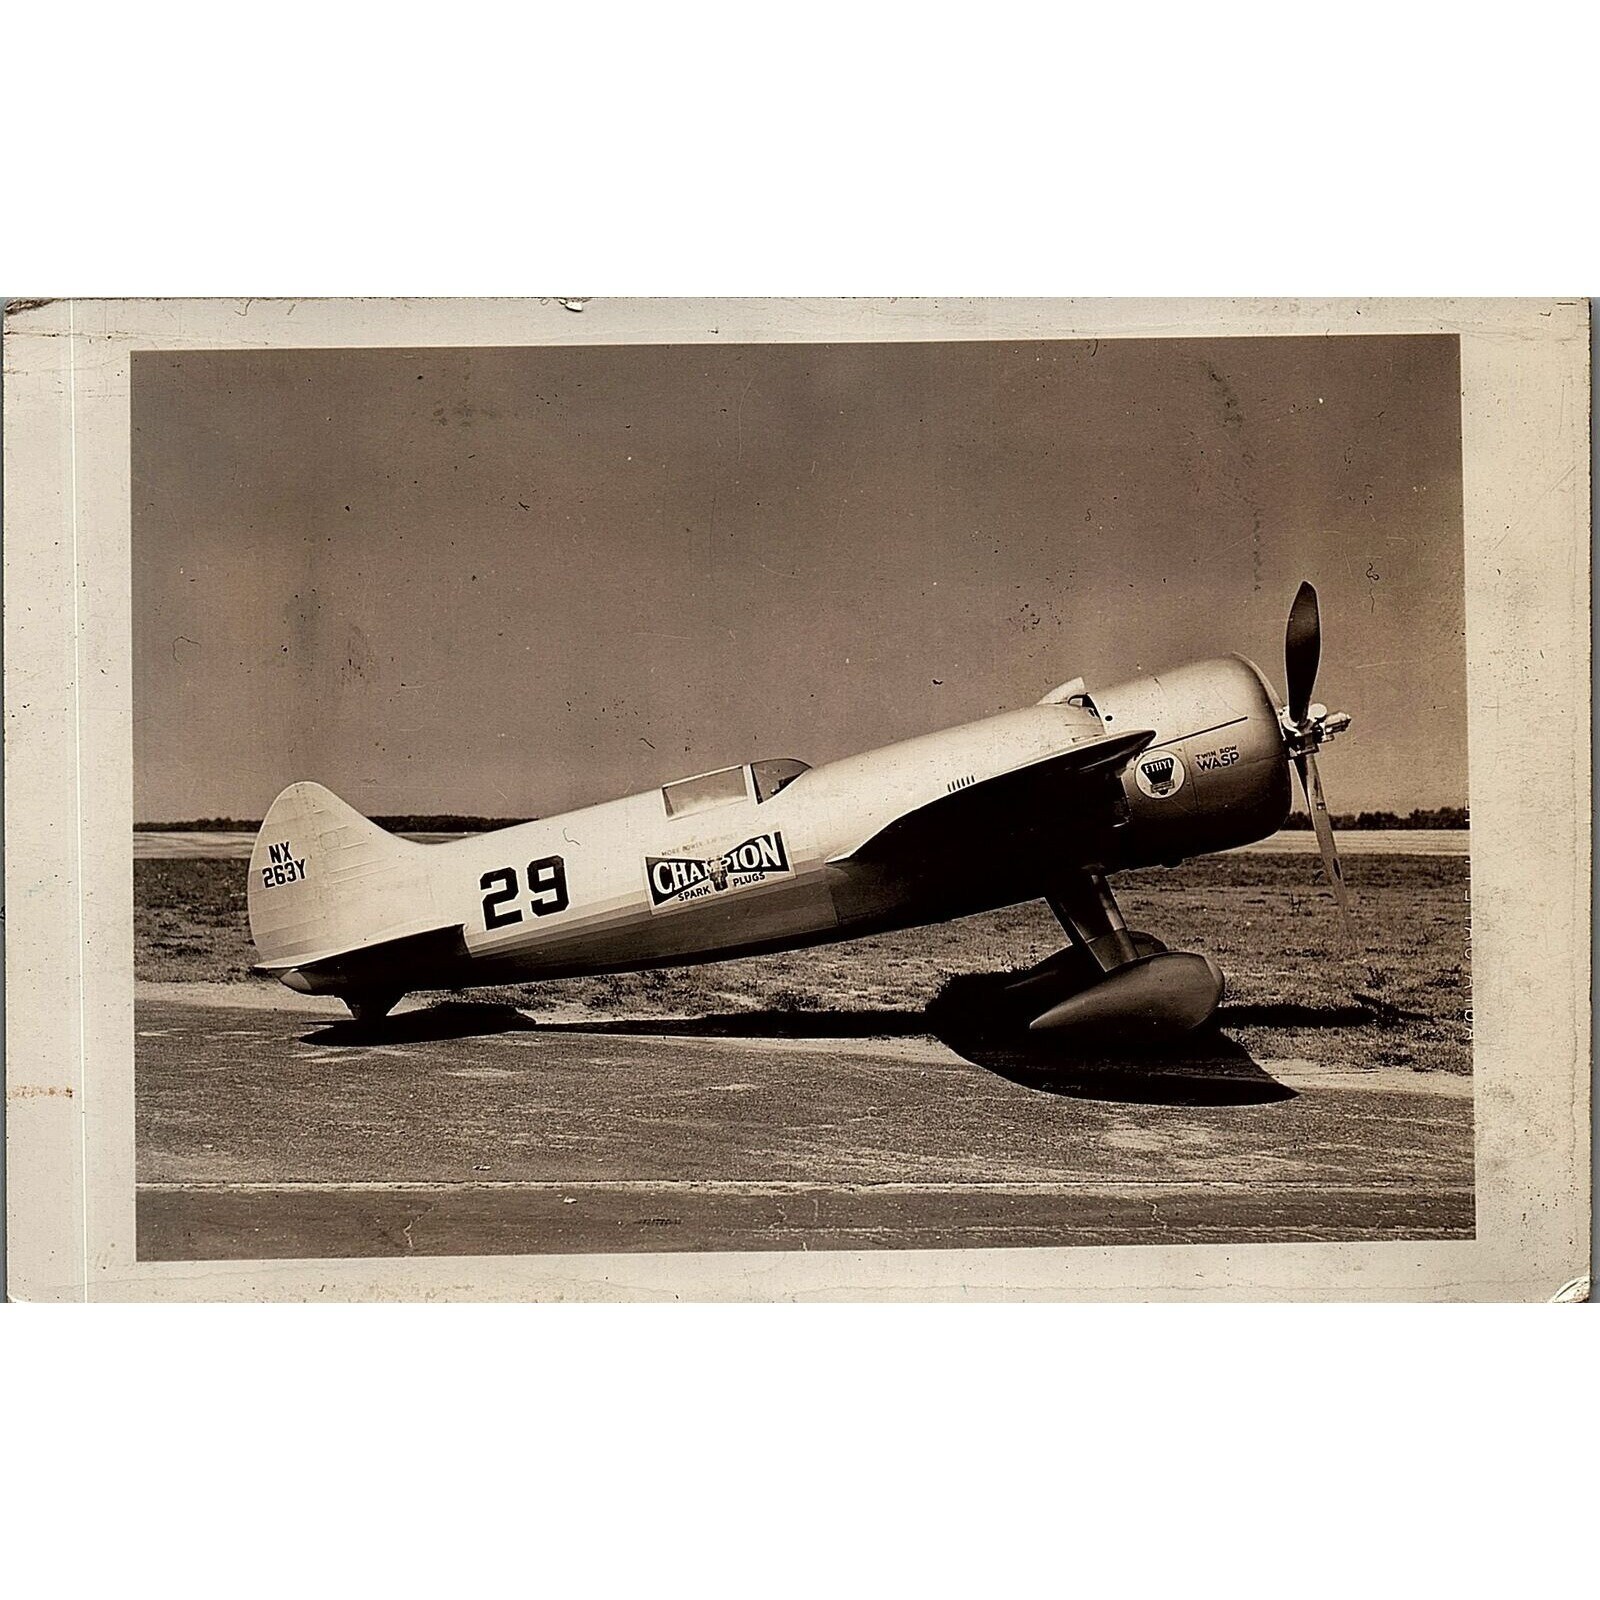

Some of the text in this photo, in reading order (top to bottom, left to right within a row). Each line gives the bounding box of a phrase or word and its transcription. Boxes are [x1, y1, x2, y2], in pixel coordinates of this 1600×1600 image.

[1194, 750, 1217, 760] TWIN
[1196, 751, 1240, 772] WASP
[268, 841, 293, 863] NX
[262, 858, 306, 888] 263Y
[480, 855, 570, 931] 29
[678, 872, 766, 902] SPARK PLUGS
